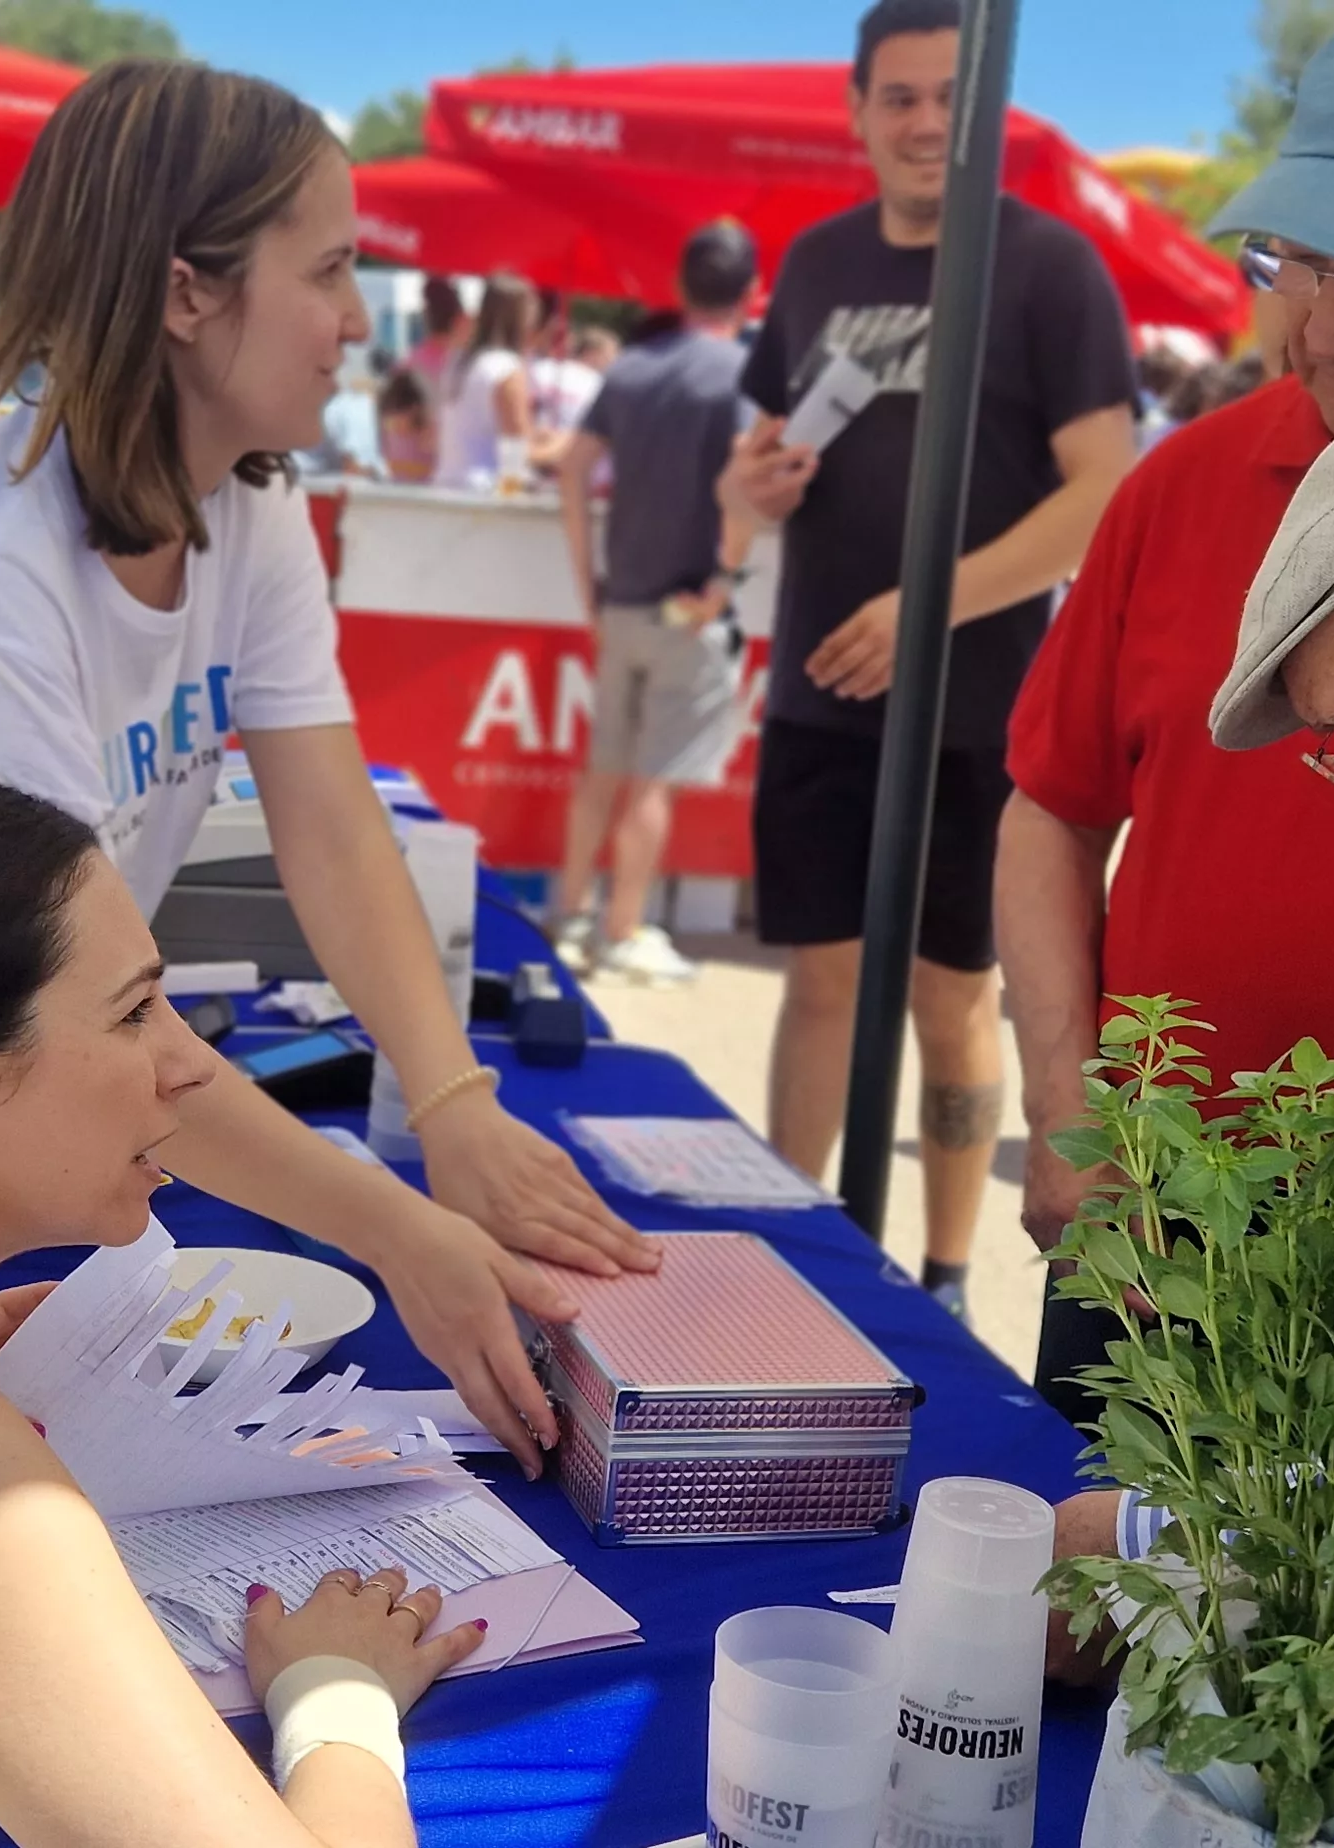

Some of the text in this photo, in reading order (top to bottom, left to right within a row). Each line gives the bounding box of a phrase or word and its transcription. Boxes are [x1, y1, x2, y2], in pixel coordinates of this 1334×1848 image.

[937, 1711, 983, 1726] SOLIDARIO
[984, 1716, 1016, 1726] FESTIVAL
[896, 1708, 1024, 1760] NEUROFES
